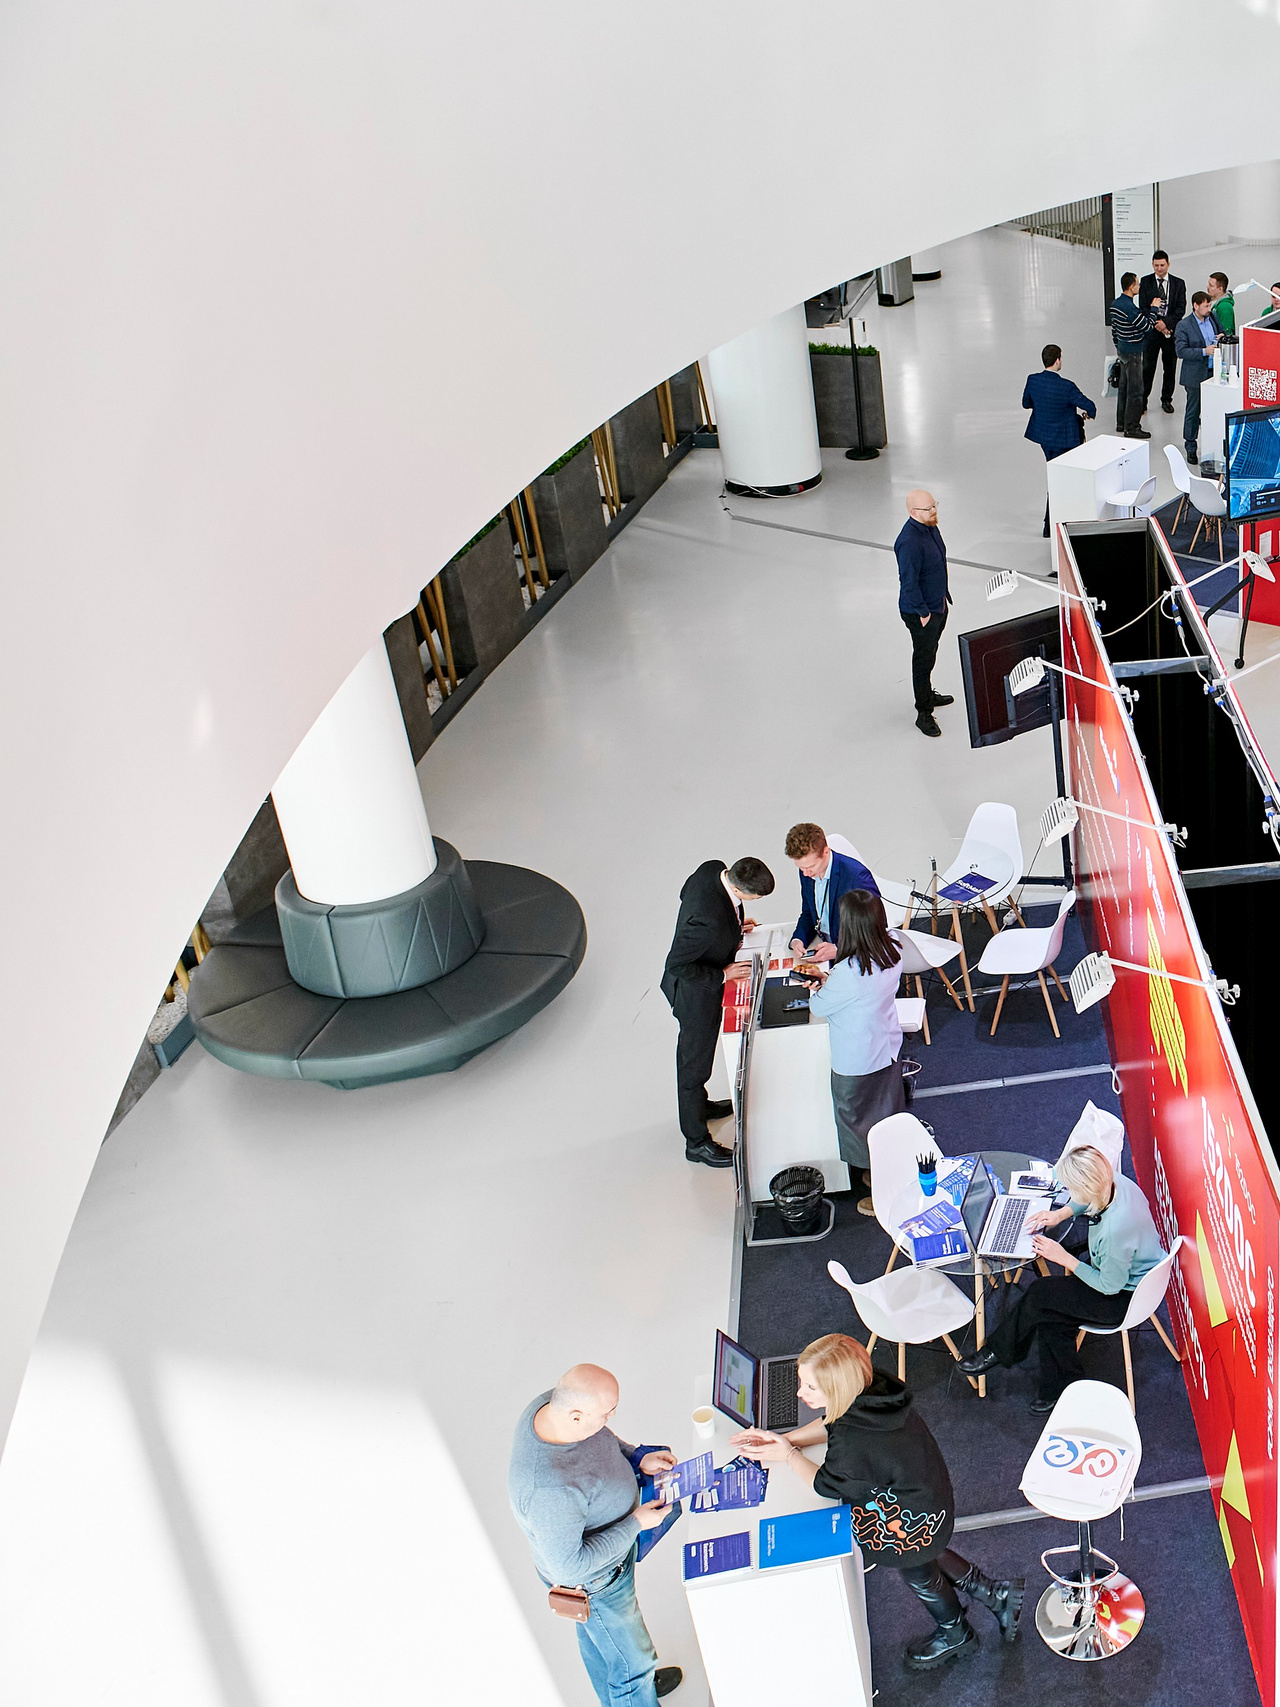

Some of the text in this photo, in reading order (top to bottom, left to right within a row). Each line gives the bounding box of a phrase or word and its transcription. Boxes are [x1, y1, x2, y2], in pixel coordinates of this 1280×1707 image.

[1202, 1096, 1256, 1308] 152DOC
[1234, 1152, 1256, 1225] 152DOC
[1266, 1264, 1275, 1461] ФОРУМ БУДУЩЕГО
